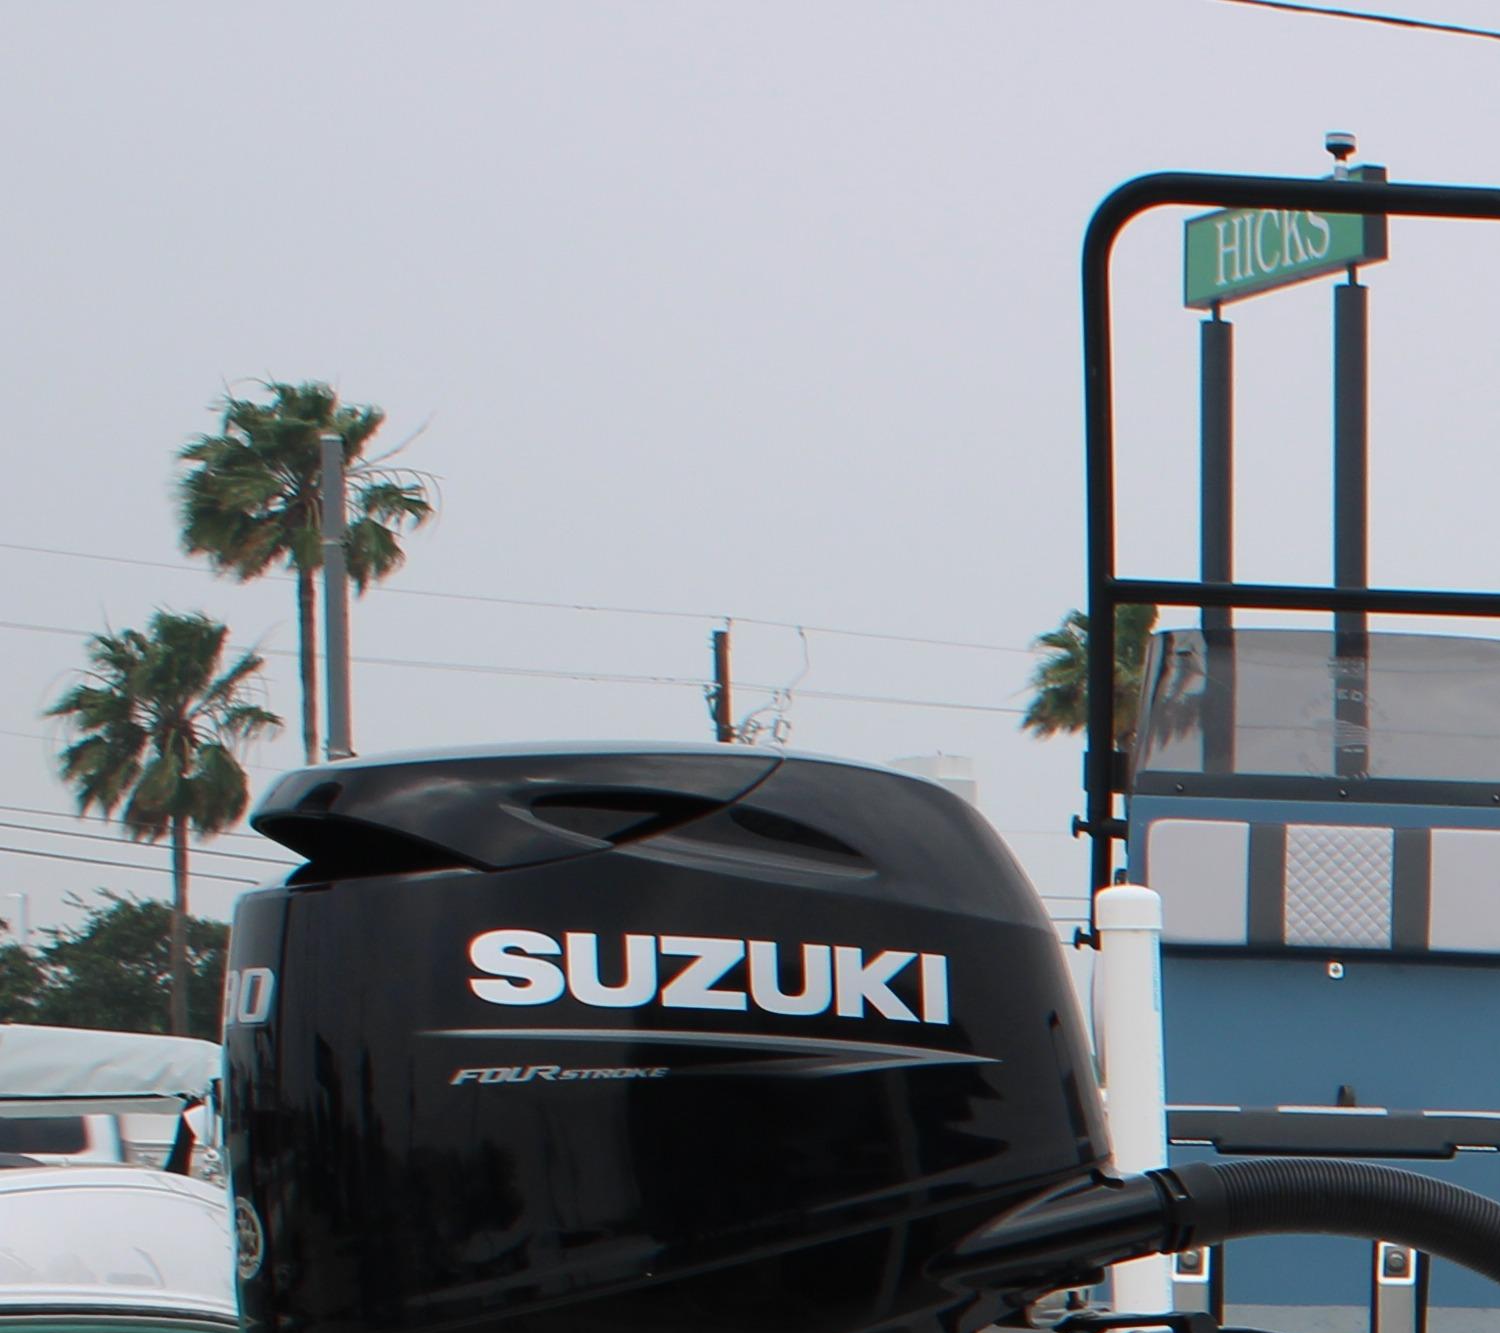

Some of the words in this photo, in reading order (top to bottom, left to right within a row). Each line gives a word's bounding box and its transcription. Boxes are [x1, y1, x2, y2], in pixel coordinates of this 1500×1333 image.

[1214, 209, 1330, 285] HICKS
[467, 929, 950, 1025] SUZUKI
[450, 1064, 559, 1085] FOUR
[559, 1067, 669, 1081] STROKE
